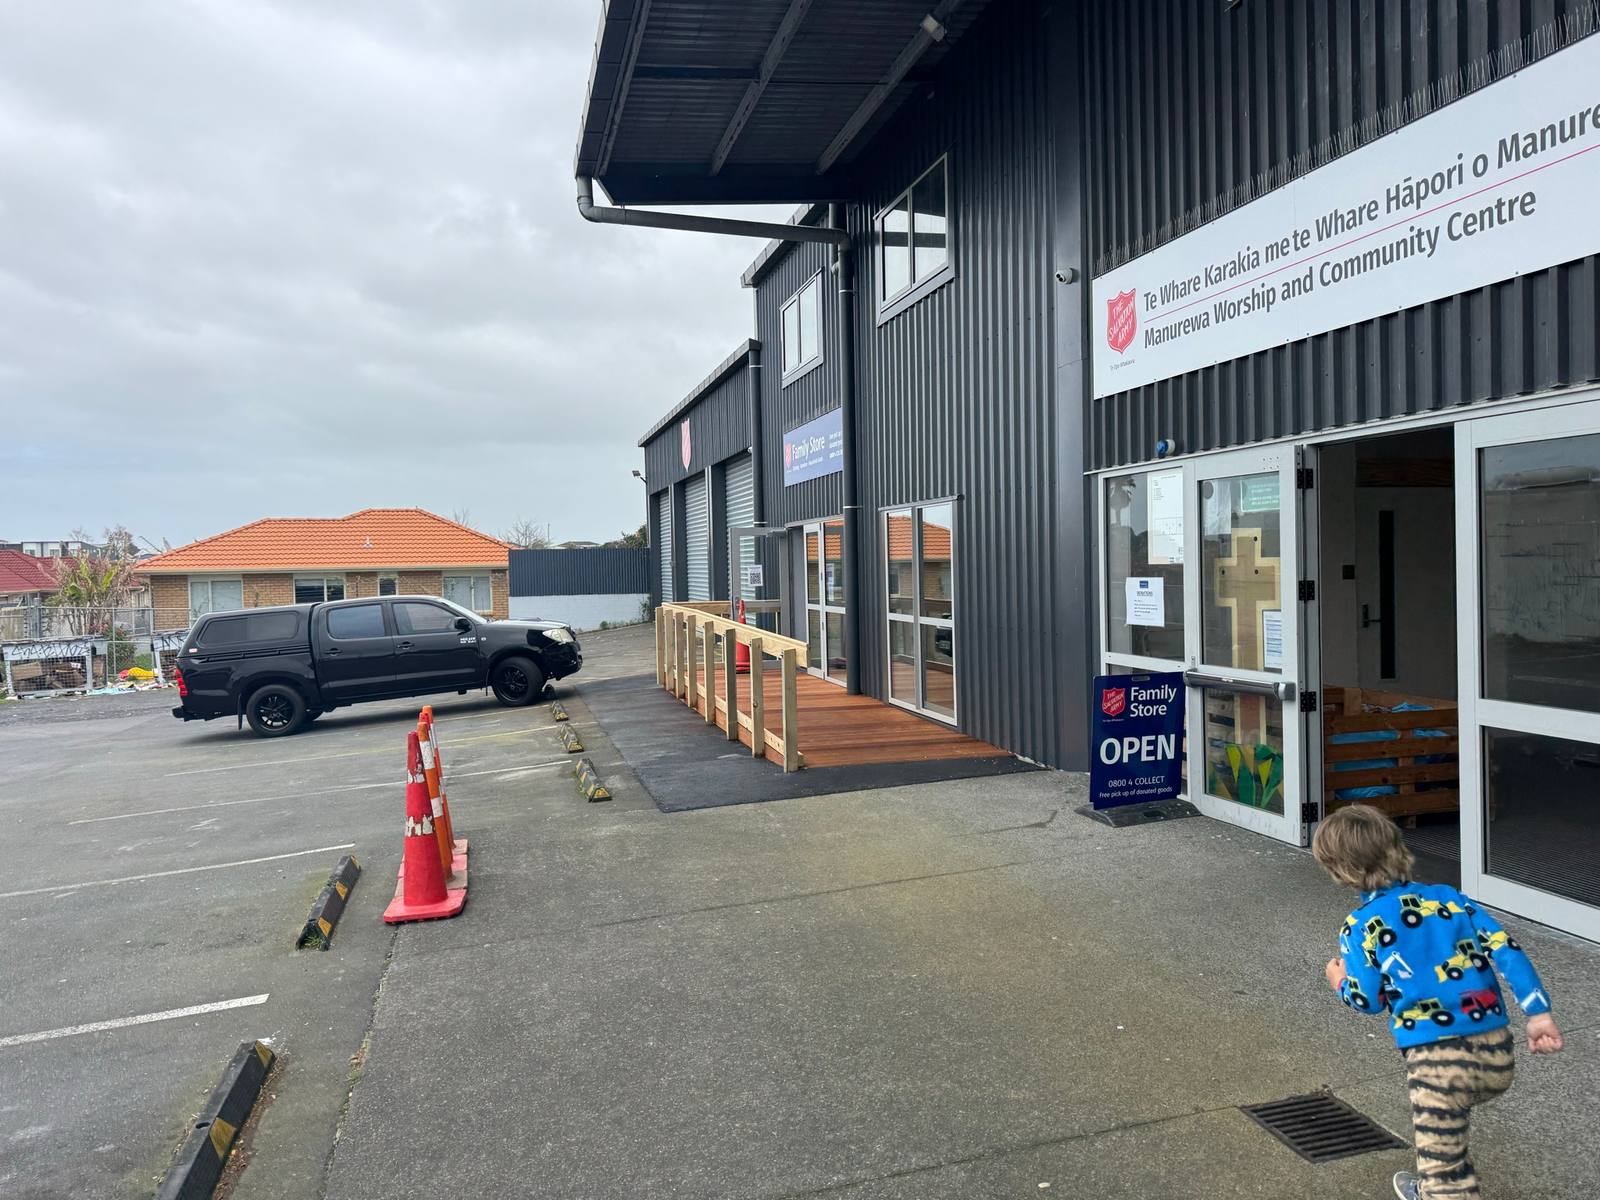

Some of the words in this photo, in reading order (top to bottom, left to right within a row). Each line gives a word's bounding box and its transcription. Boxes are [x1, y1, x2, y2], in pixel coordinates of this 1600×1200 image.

[1143, 291, 1157, 312] Te
[1160, 275, 1201, 306] Whare
[1204, 245, 1260, 288] Karakia
[1265, 237, 1290, 263] me
[1292, 229, 1311, 252] te
[1315, 199, 1379, 242] Whare
[1386, 153, 1464, 214] Hāpori
[1472, 153, 1489, 178] o
[1144, 311, 1210, 349] Manurewa
[1213, 282, 1276, 324] Worship
[1281, 266, 1314, 302] and
[1319, 225, 1440, 287] Community
[1447, 191, 1536, 242] Centre
[1112, 299, 1124, 320] THE
[792, 439, 809, 462] Family
[809, 436, 825, 454] Store
[1130, 684, 1177, 703] Family
[1129, 703, 1167, 717] Store
[1100, 733, 1176, 765] OPEN
[1108, 778, 1127, 788] 0800
[1134, 776, 1165, 786] COLLECT
[1136, 787, 1157, 795] donated
[1157, 786, 1173, 794] goods
